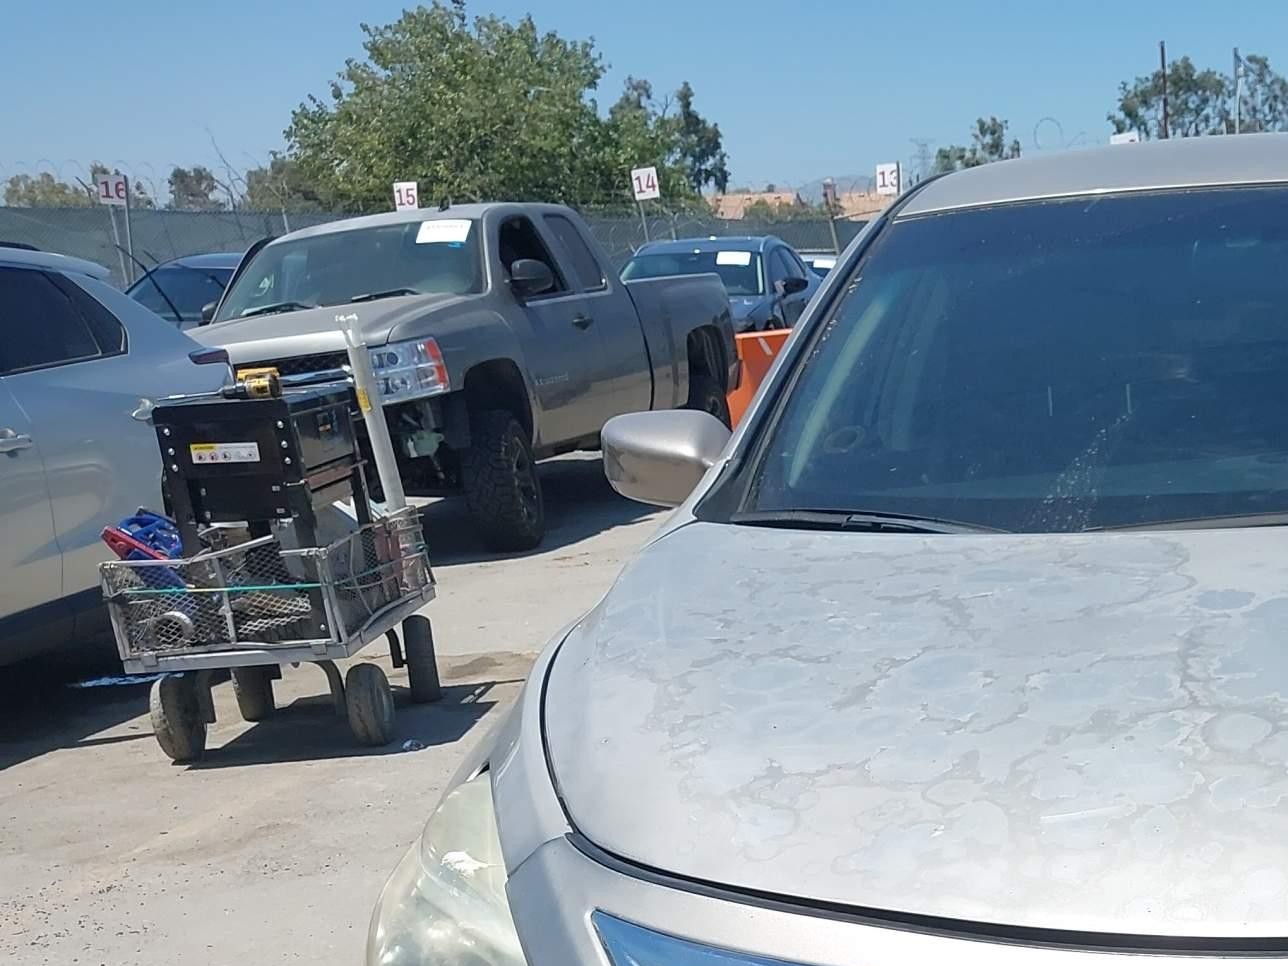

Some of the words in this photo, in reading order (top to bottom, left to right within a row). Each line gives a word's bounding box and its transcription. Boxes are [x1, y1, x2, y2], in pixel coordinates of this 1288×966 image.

[100, 181, 125, 199] 16
[634, 173, 656, 194] 14
[396, 187, 416, 206] 15
